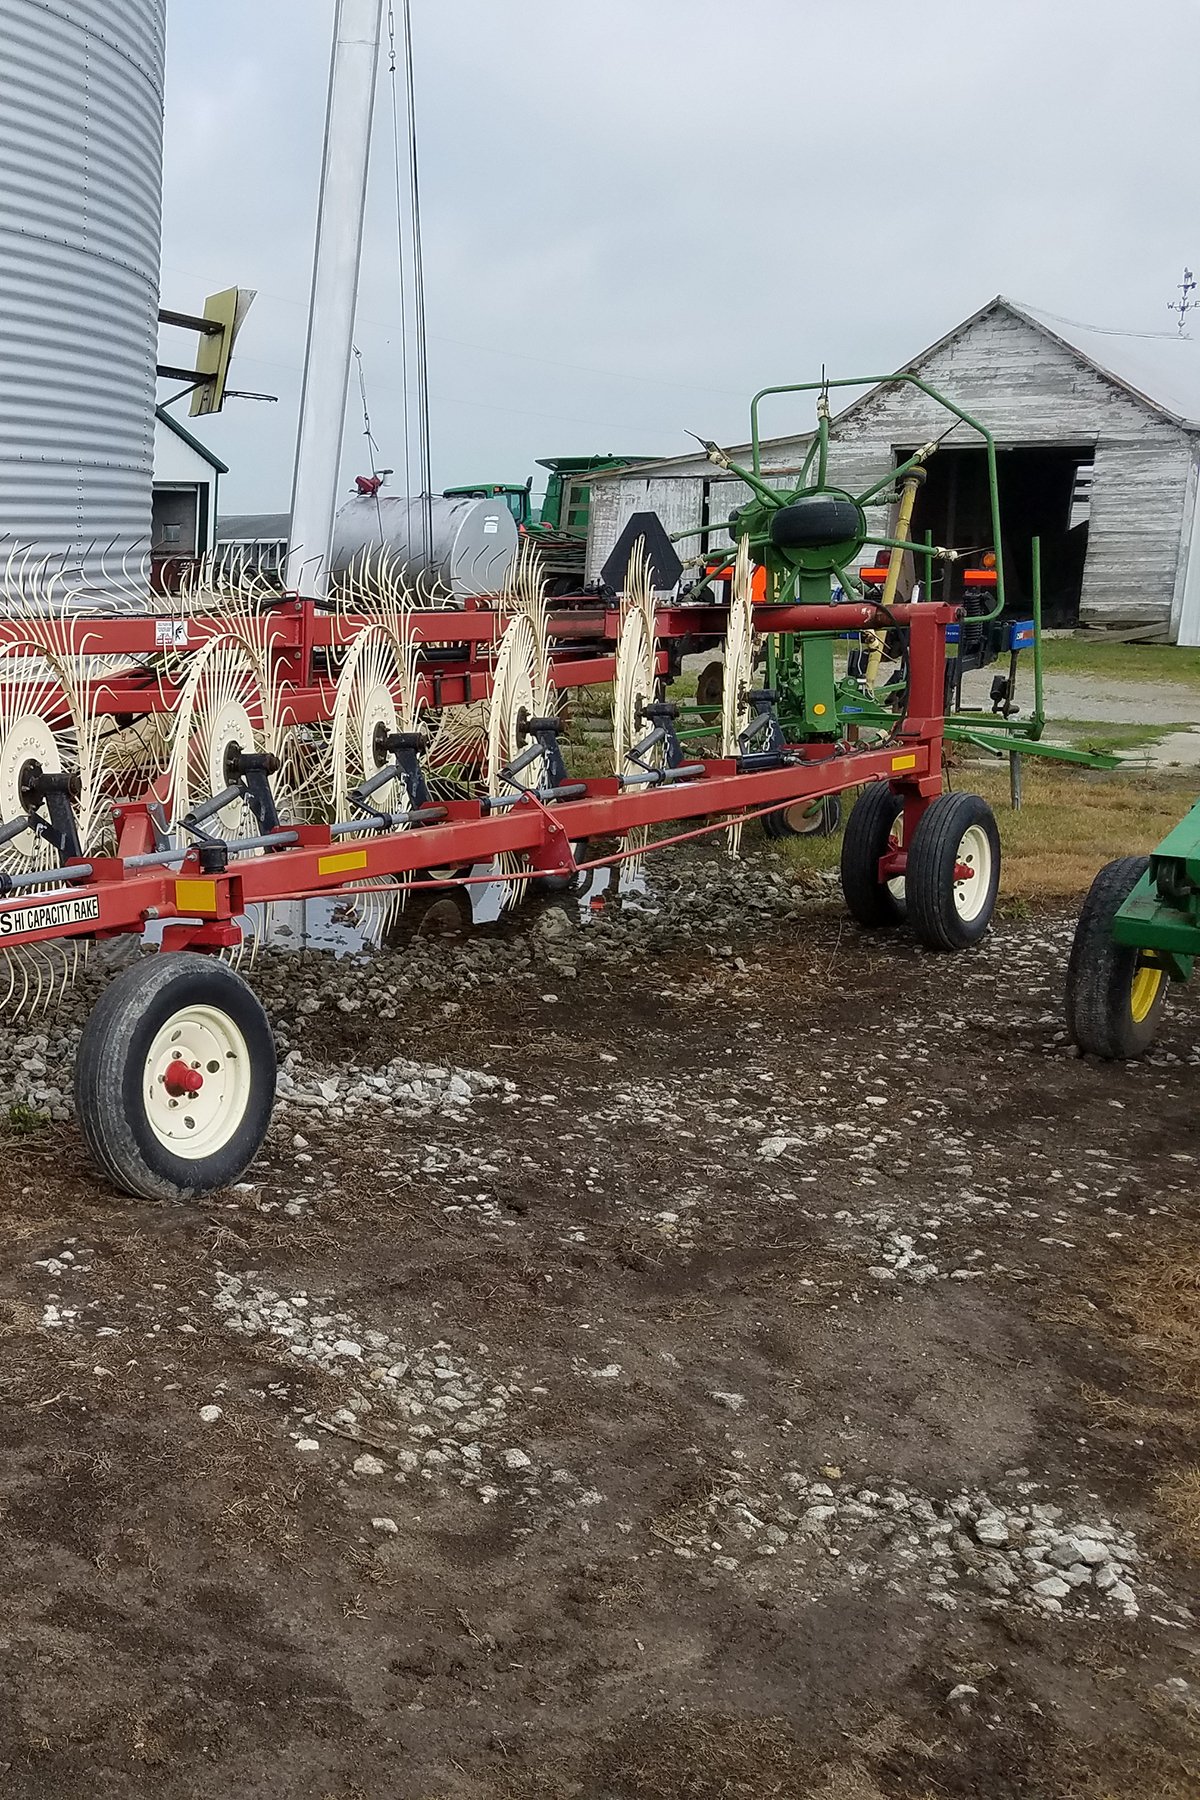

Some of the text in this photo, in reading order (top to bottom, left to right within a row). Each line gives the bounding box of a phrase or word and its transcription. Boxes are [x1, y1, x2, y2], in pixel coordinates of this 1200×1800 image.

[15, 912, 25, 931] HI
[27, 904, 71, 929] CAPACITY
[74, 899, 98, 919] RAKE
